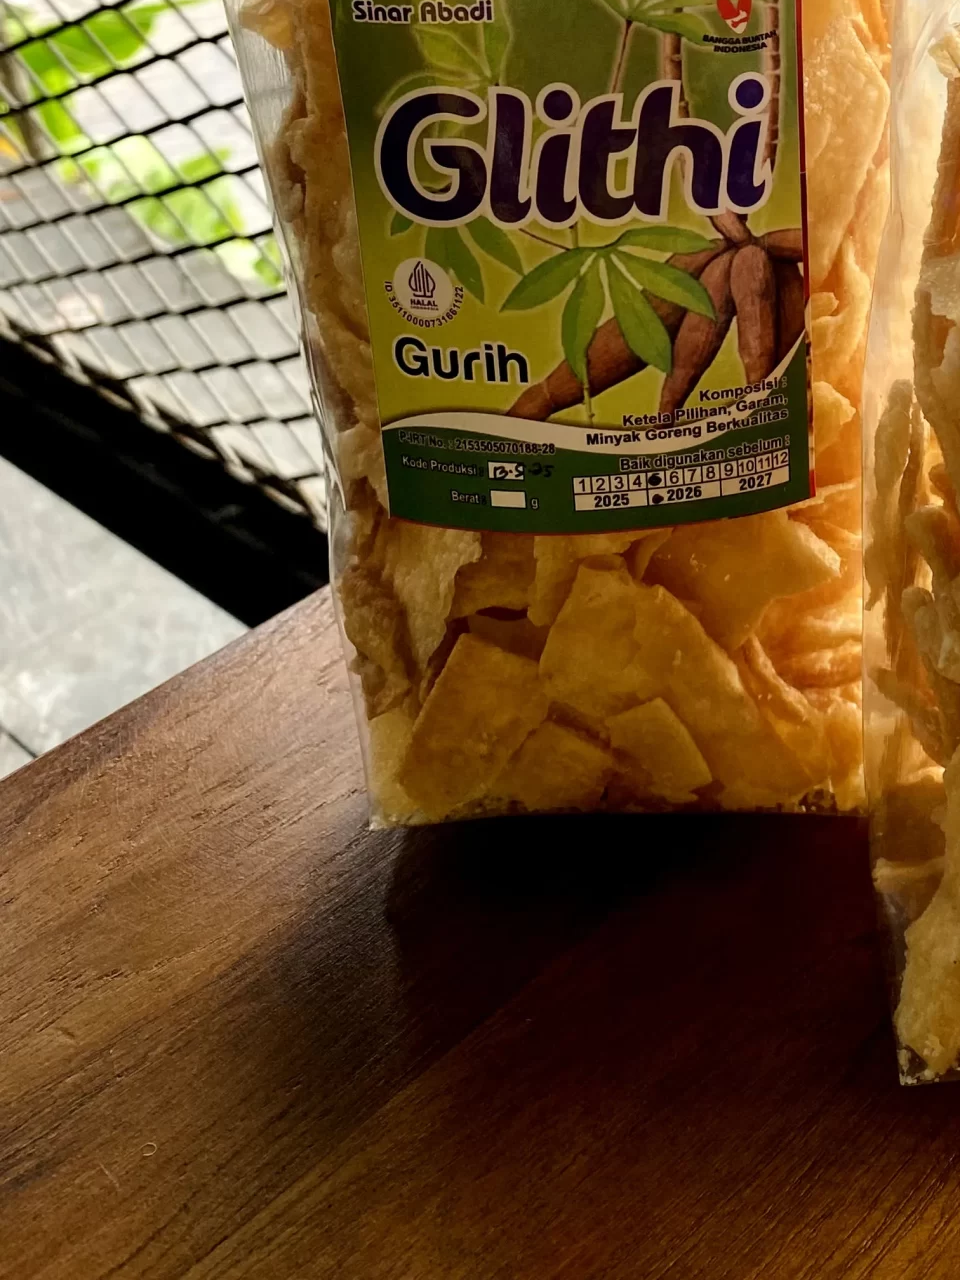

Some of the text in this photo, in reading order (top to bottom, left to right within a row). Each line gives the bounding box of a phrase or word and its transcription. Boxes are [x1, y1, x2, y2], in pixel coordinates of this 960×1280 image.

[352, 0, 494, 24] Sinar Abadi
[702, 29, 777, 45] BANGGA BUATAN
[713, 42, 767, 53] INDONESIA
[374, 71, 772, 228] Glithi
[410, 298, 438, 307] HALAL
[393, 334, 530, 385] Gurih
[699, 378, 779, 402] Komposisi
[622, 394, 788, 427] Ketela Pilihan, Garam,
[586, 409, 788, 447] Minyak Goreng Berkualitas
[455, 438, 556, 455] 2153505070188-28
[620, 455, 651, 471] Baik
[653, 447, 724, 470] digunakan
[727, 436, 782, 456] sebelum
[402, 455, 428, 469] Kode
[430, 459, 477, 475] Produksi
[578, 479, 586, 492] 1
[595, 478, 606, 492] 2
[614, 476, 624, 490] 3
[632, 474, 643, 488] 4
[669, 471, 679, 485] 6
[688, 469, 698, 482] 7
[706, 466, 716, 479] 8
[724, 463, 733, 477] 9
[739, 459, 754, 474] 10
[758, 456, 771, 470] 11
[773, 452, 788, 466] 12
[451, 490, 480, 505] Berat
[531, 498, 539, 509] g
[594, 472, 773, 508] 2025 2026 2027
